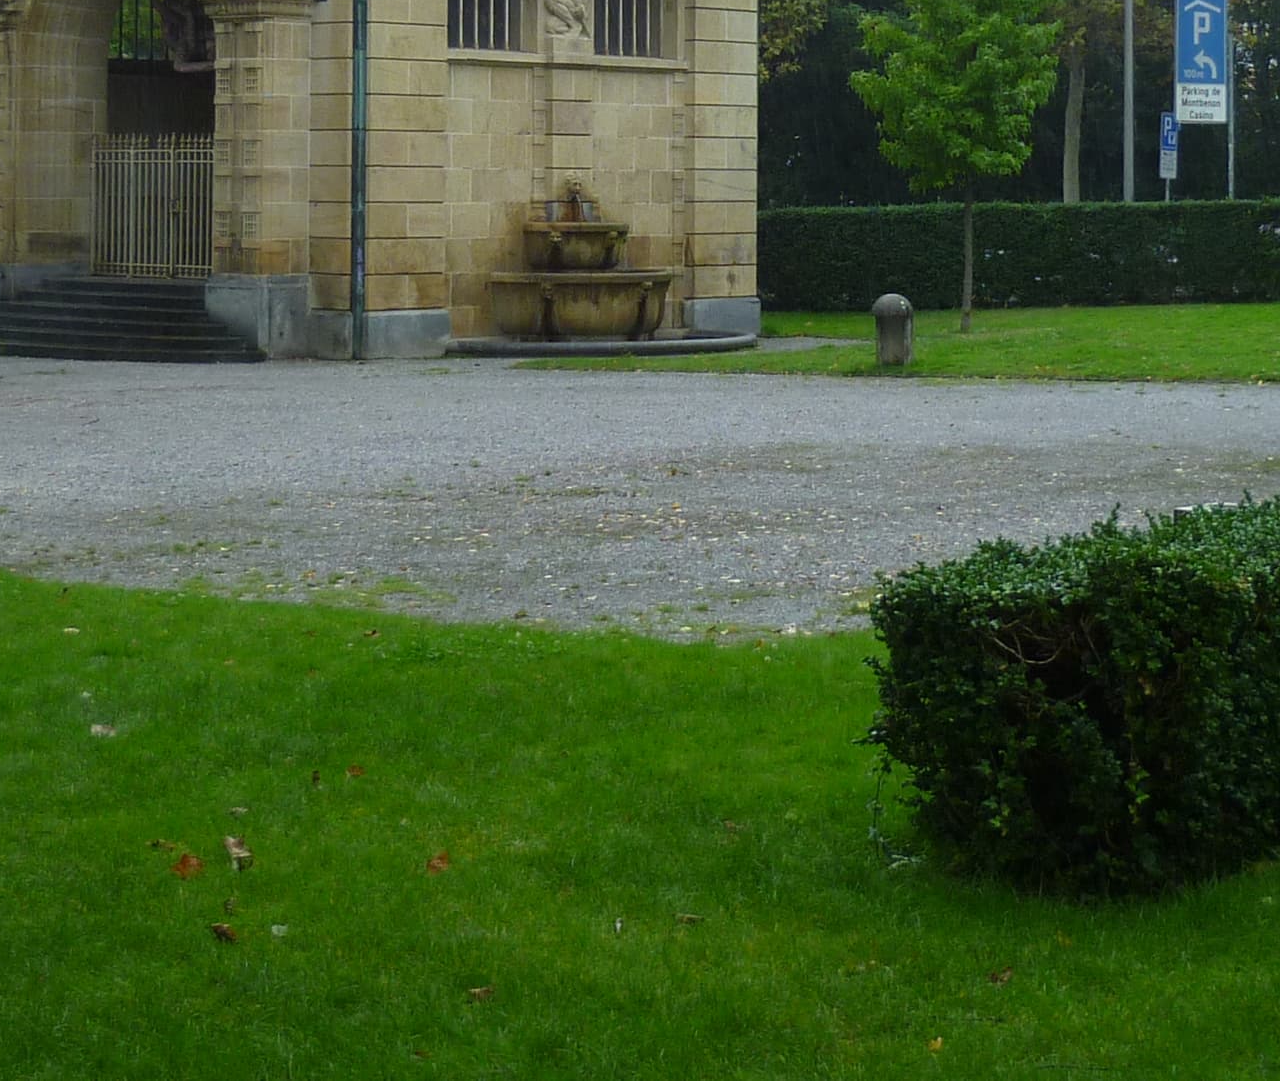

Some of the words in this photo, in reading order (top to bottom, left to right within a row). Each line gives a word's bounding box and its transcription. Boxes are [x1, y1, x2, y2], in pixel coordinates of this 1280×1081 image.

[1193, 11, 1211, 45] P
[1181, 86, 1209, 97] Parking
[1211, 86, 1221, 96] de
[1189, 110, 1214, 120] Casino
[1164, 117, 1172, 136] P
